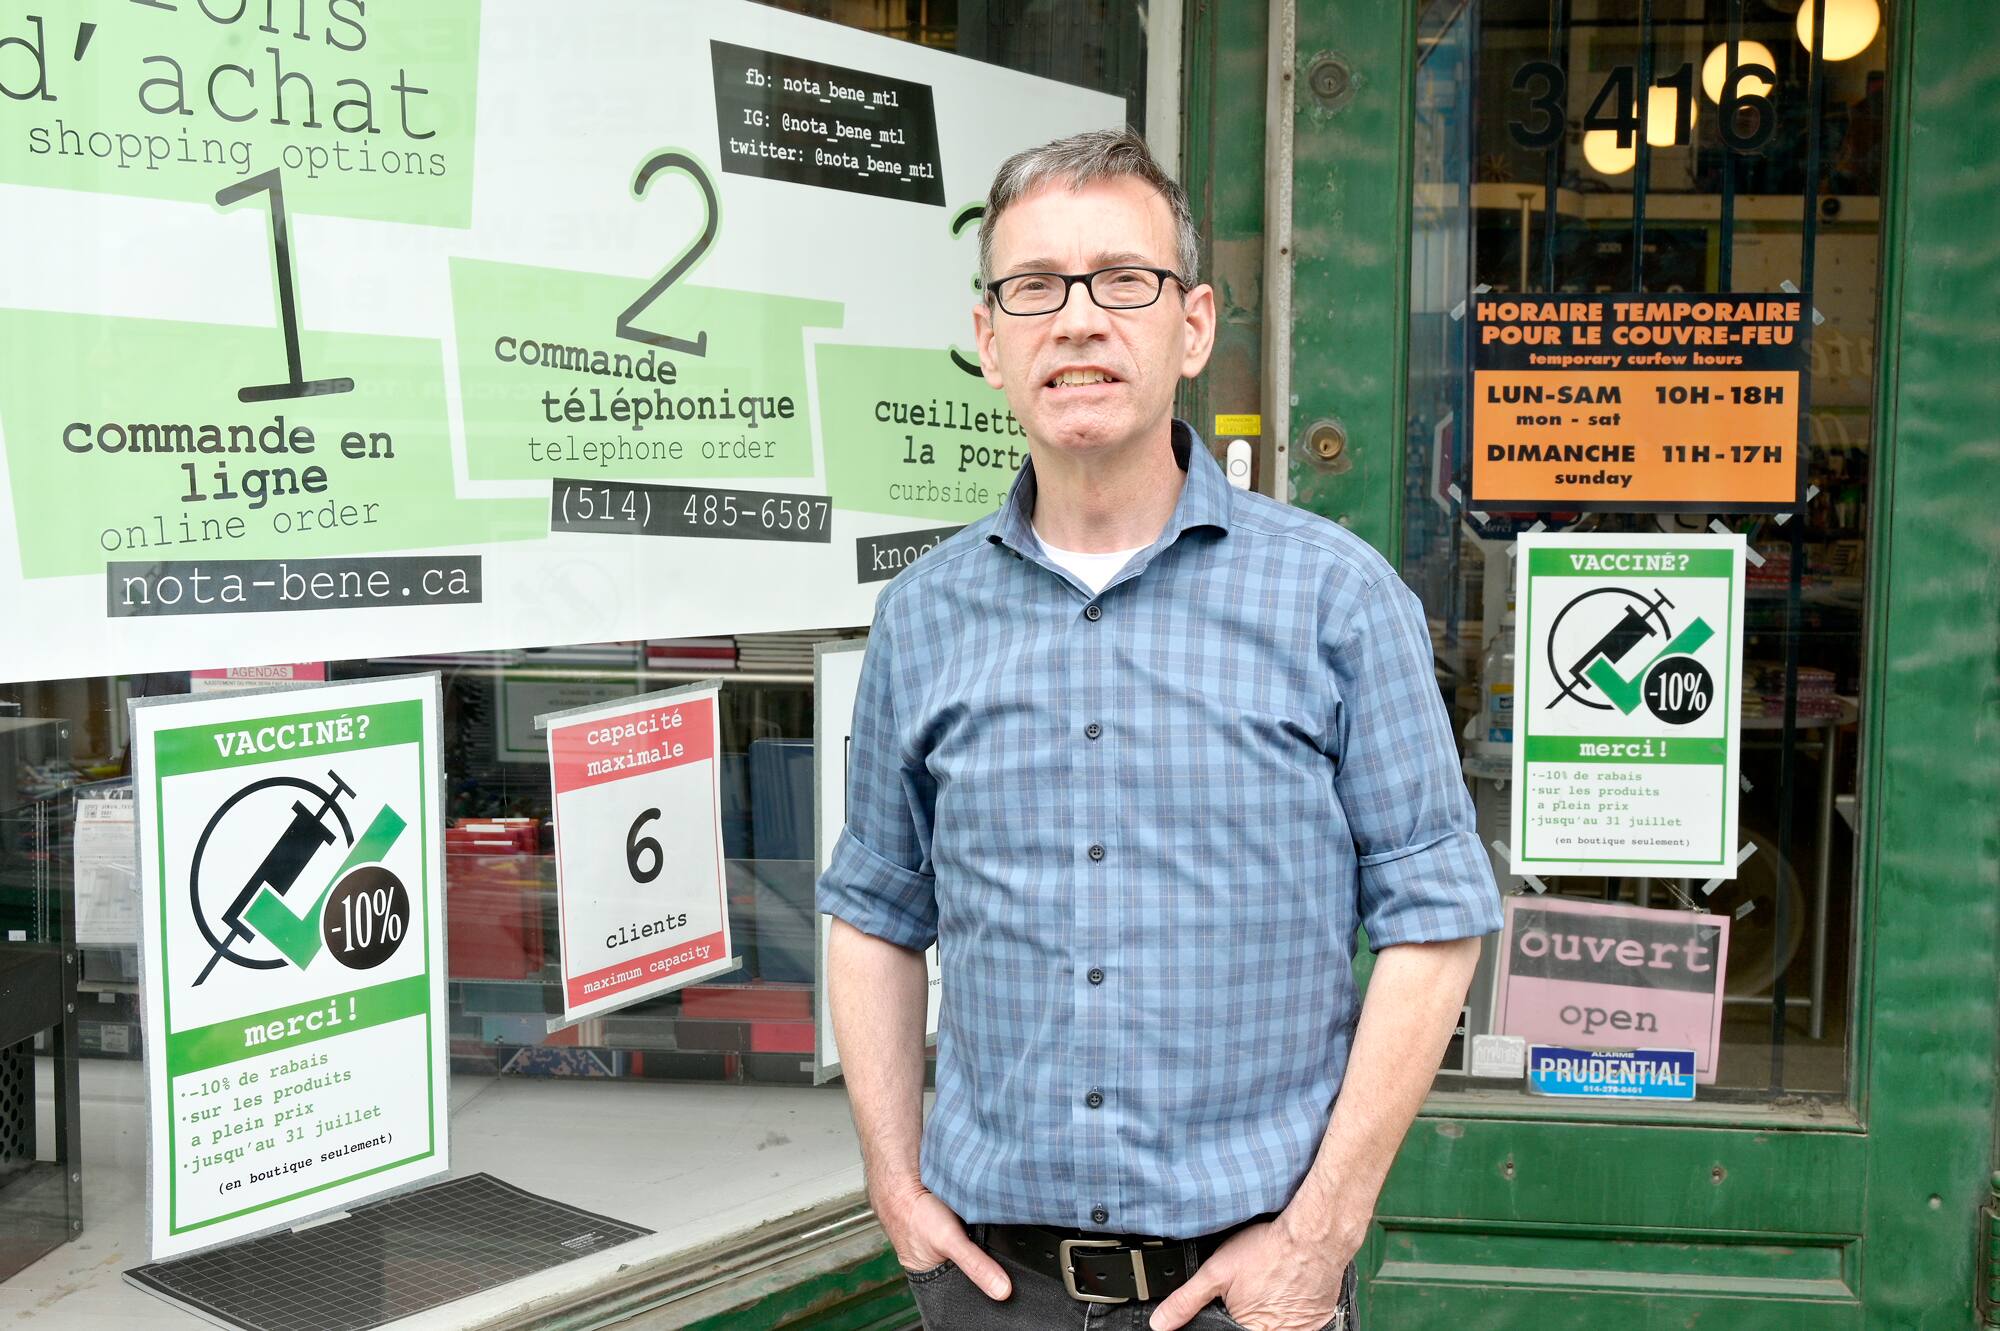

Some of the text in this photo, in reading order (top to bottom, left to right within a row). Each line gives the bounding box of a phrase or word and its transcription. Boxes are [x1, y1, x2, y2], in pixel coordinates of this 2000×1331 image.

[745, 68, 899, 110] fb: nota_bene_mtl
[1509, 62, 1776, 151] 3416
[743, 109, 905, 148] IG: @nota_bene_mtl
[29, 119, 447, 179] shopping options
[730, 137, 934, 182] twitter: @nota_bene_mtl
[615, 152, 719, 357] 2
[215, 167, 355, 402] 1
[1476, 302, 1801, 322] HORAIRE TEMPORAIRE
[1482, 326, 1794, 345] POUR LE COUVRE-FEU
[494, 335, 677, 386] commande
[1529, 352, 1743, 368] temporary curfew hours
[541, 386, 795, 431] téléphonique
[1487, 386, 1621, 405] LUN-SAM
[62, 416, 395, 460] commande en
[1516, 413, 1561, 426] mon
[1588, 413, 1620, 426] sat
[527, 434, 776, 468] telephone order
[903, 435, 935, 465] la
[1487, 445, 1635, 463] DIMANCHE
[181, 461, 329, 509] ligne
[889, 480, 989, 504] curbside
[1555, 470, 1633, 488] sunday
[100, 499, 380, 551] online order
[561, 485, 829, 531] (514) 485-6587
[1570, 551, 1690, 572] VACCINÉ?
[121, 563, 470, 606] nota-bene.ca
[232, 667, 288, 677] AGENDAS
[1649, 672, 1707, 712] -10%
[214, 714, 371, 758] VACCINÉ?
[587, 707, 683, 748] capacité
[587, 740, 683, 778] maximale
[1579, 739, 1667, 758] merci!
[1538, 786, 1660, 797] sur les produits
[1573, 771, 1589, 781] de
[1597, 771, 1642, 781] rabais
[1537, 800, 1629, 812] a plein prix
[1606, 817, 1620, 826] 31
[1629, 816, 1682, 827] juillet
[626, 807, 664, 884] 6
[1555, 836, 1691, 847] (en boutique seulement)
[331, 884, 403, 953] -10%
[605, 910, 688, 950] clients
[583, 943, 711, 994] maximum capacity
[1519, 927, 1711, 974] ouvert
[244, 996, 359, 1048] merci!
[1560, 1004, 1659, 1035] open
[238, 1072, 259, 1086] de
[270, 1052, 329, 1078] rabais
[1540, 1057, 1686, 1087] PRUDENTIAL
[1591, 1051, 1635, 1059] ALARME
[190, 1069, 352, 1124] sur les produits
[191, 1102, 314, 1147] a plein prix
[286, 1126, 305, 1143] 31
[315, 1104, 381, 1137] juillet
[218, 1133, 393, 1195] (en boutique seulement)
